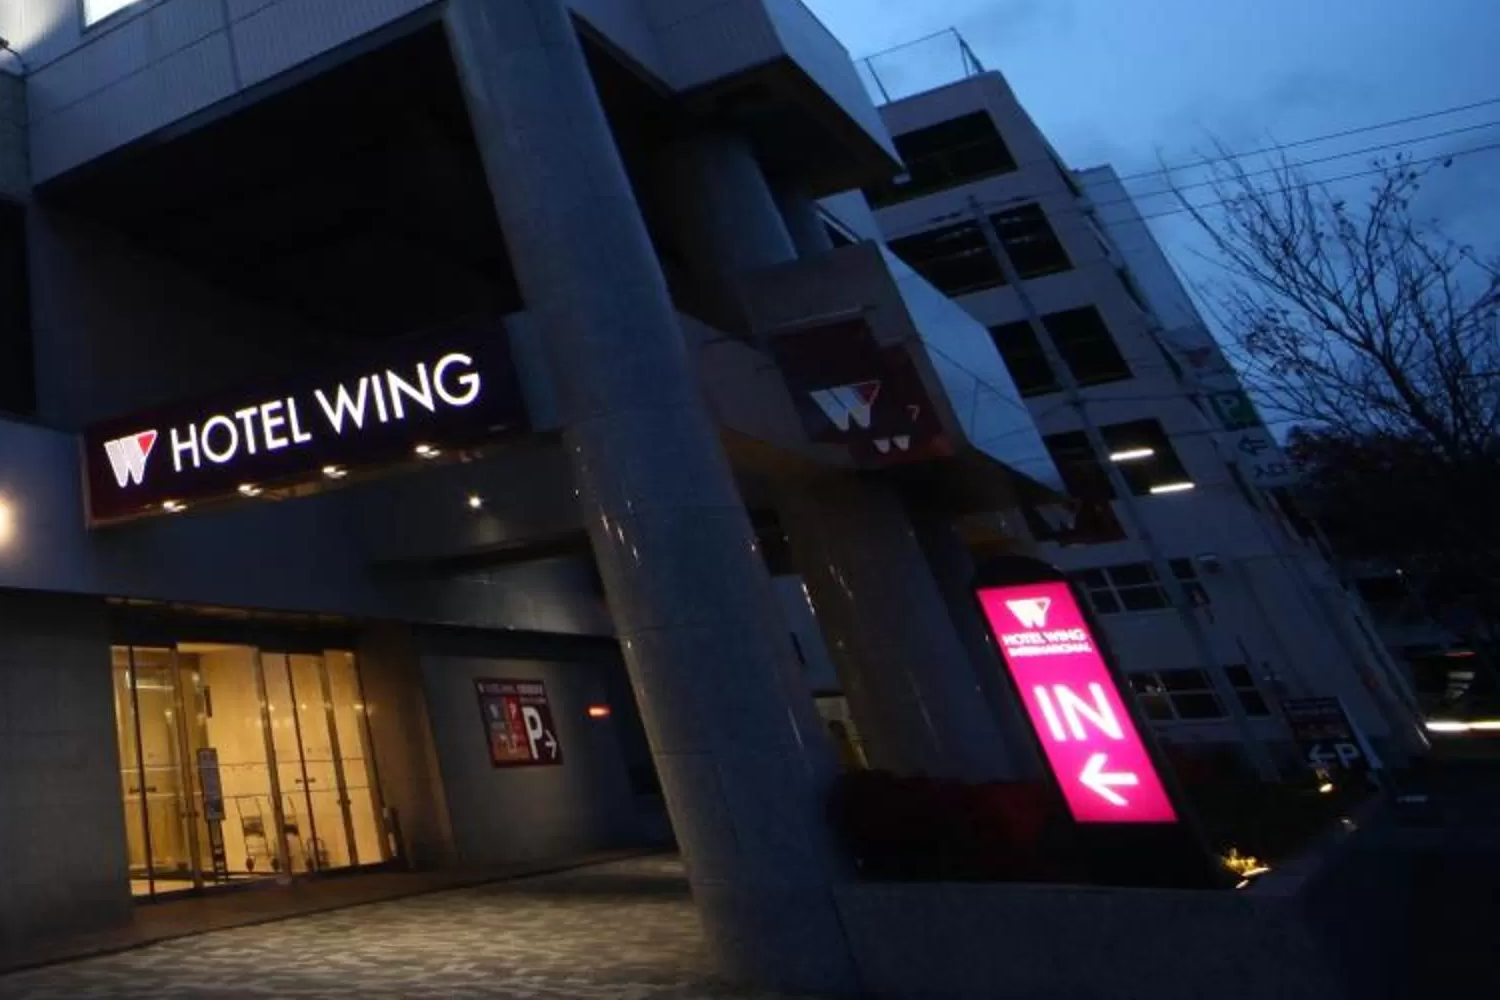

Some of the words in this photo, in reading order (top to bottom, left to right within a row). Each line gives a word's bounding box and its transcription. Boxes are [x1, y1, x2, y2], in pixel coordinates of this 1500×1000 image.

[170, 397, 312, 472] HOTEL
[314, 352, 482, 434] WING
[521, 705, 543, 760] P
[1033, 682, 1125, 742] IN
